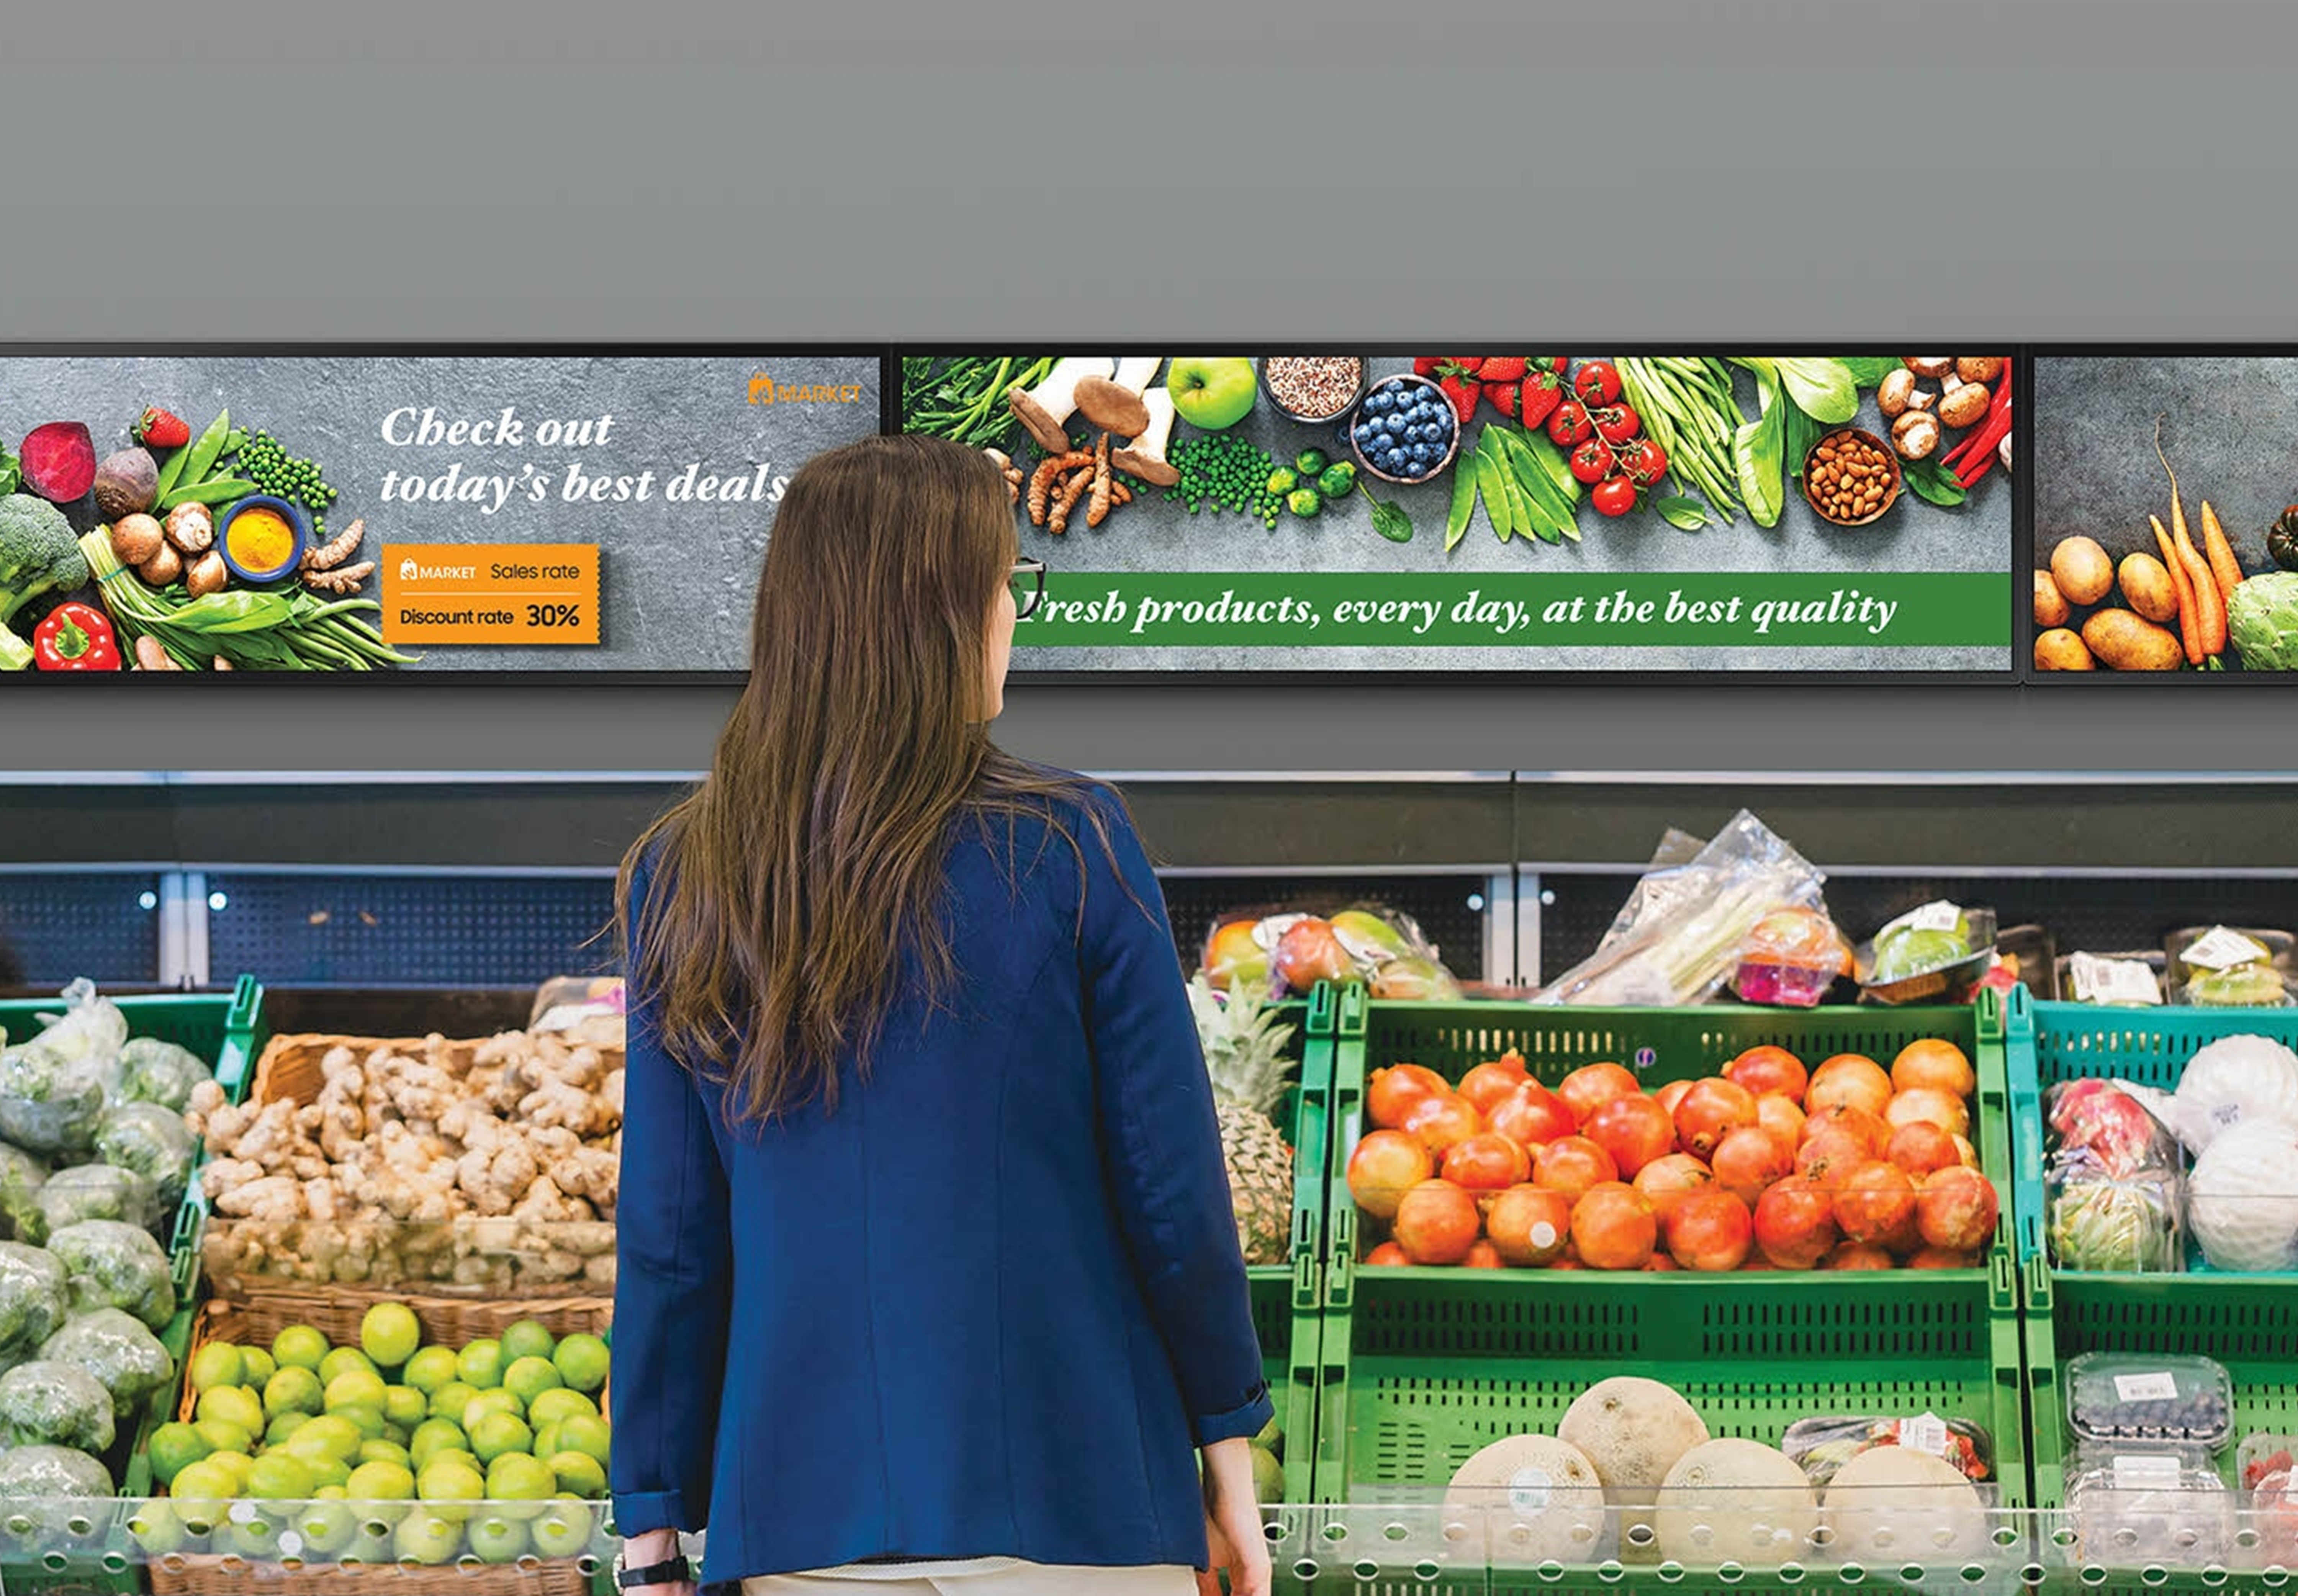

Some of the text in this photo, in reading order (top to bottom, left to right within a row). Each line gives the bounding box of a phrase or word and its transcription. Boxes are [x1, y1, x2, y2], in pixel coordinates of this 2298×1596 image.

[777, 385, 862, 403] MARKET
[381, 406, 616, 447] Check out
[380, 462, 790, 515] today's best deals
[420, 566, 476, 579] MARKET
[491, 563, 580, 579] Sales rate
[400, 604, 580, 627] Discount rate 30%
[1129, 589, 1320, 633] products,
[1333, 601, 1442, 634] every
[1451, 589, 1530, 634] day,
[1542, 597, 1586, 623] at
[1594, 589, 1655, 623] the
[1665, 589, 1743, 623] best
[1751, 589, 1897, 634] quality
